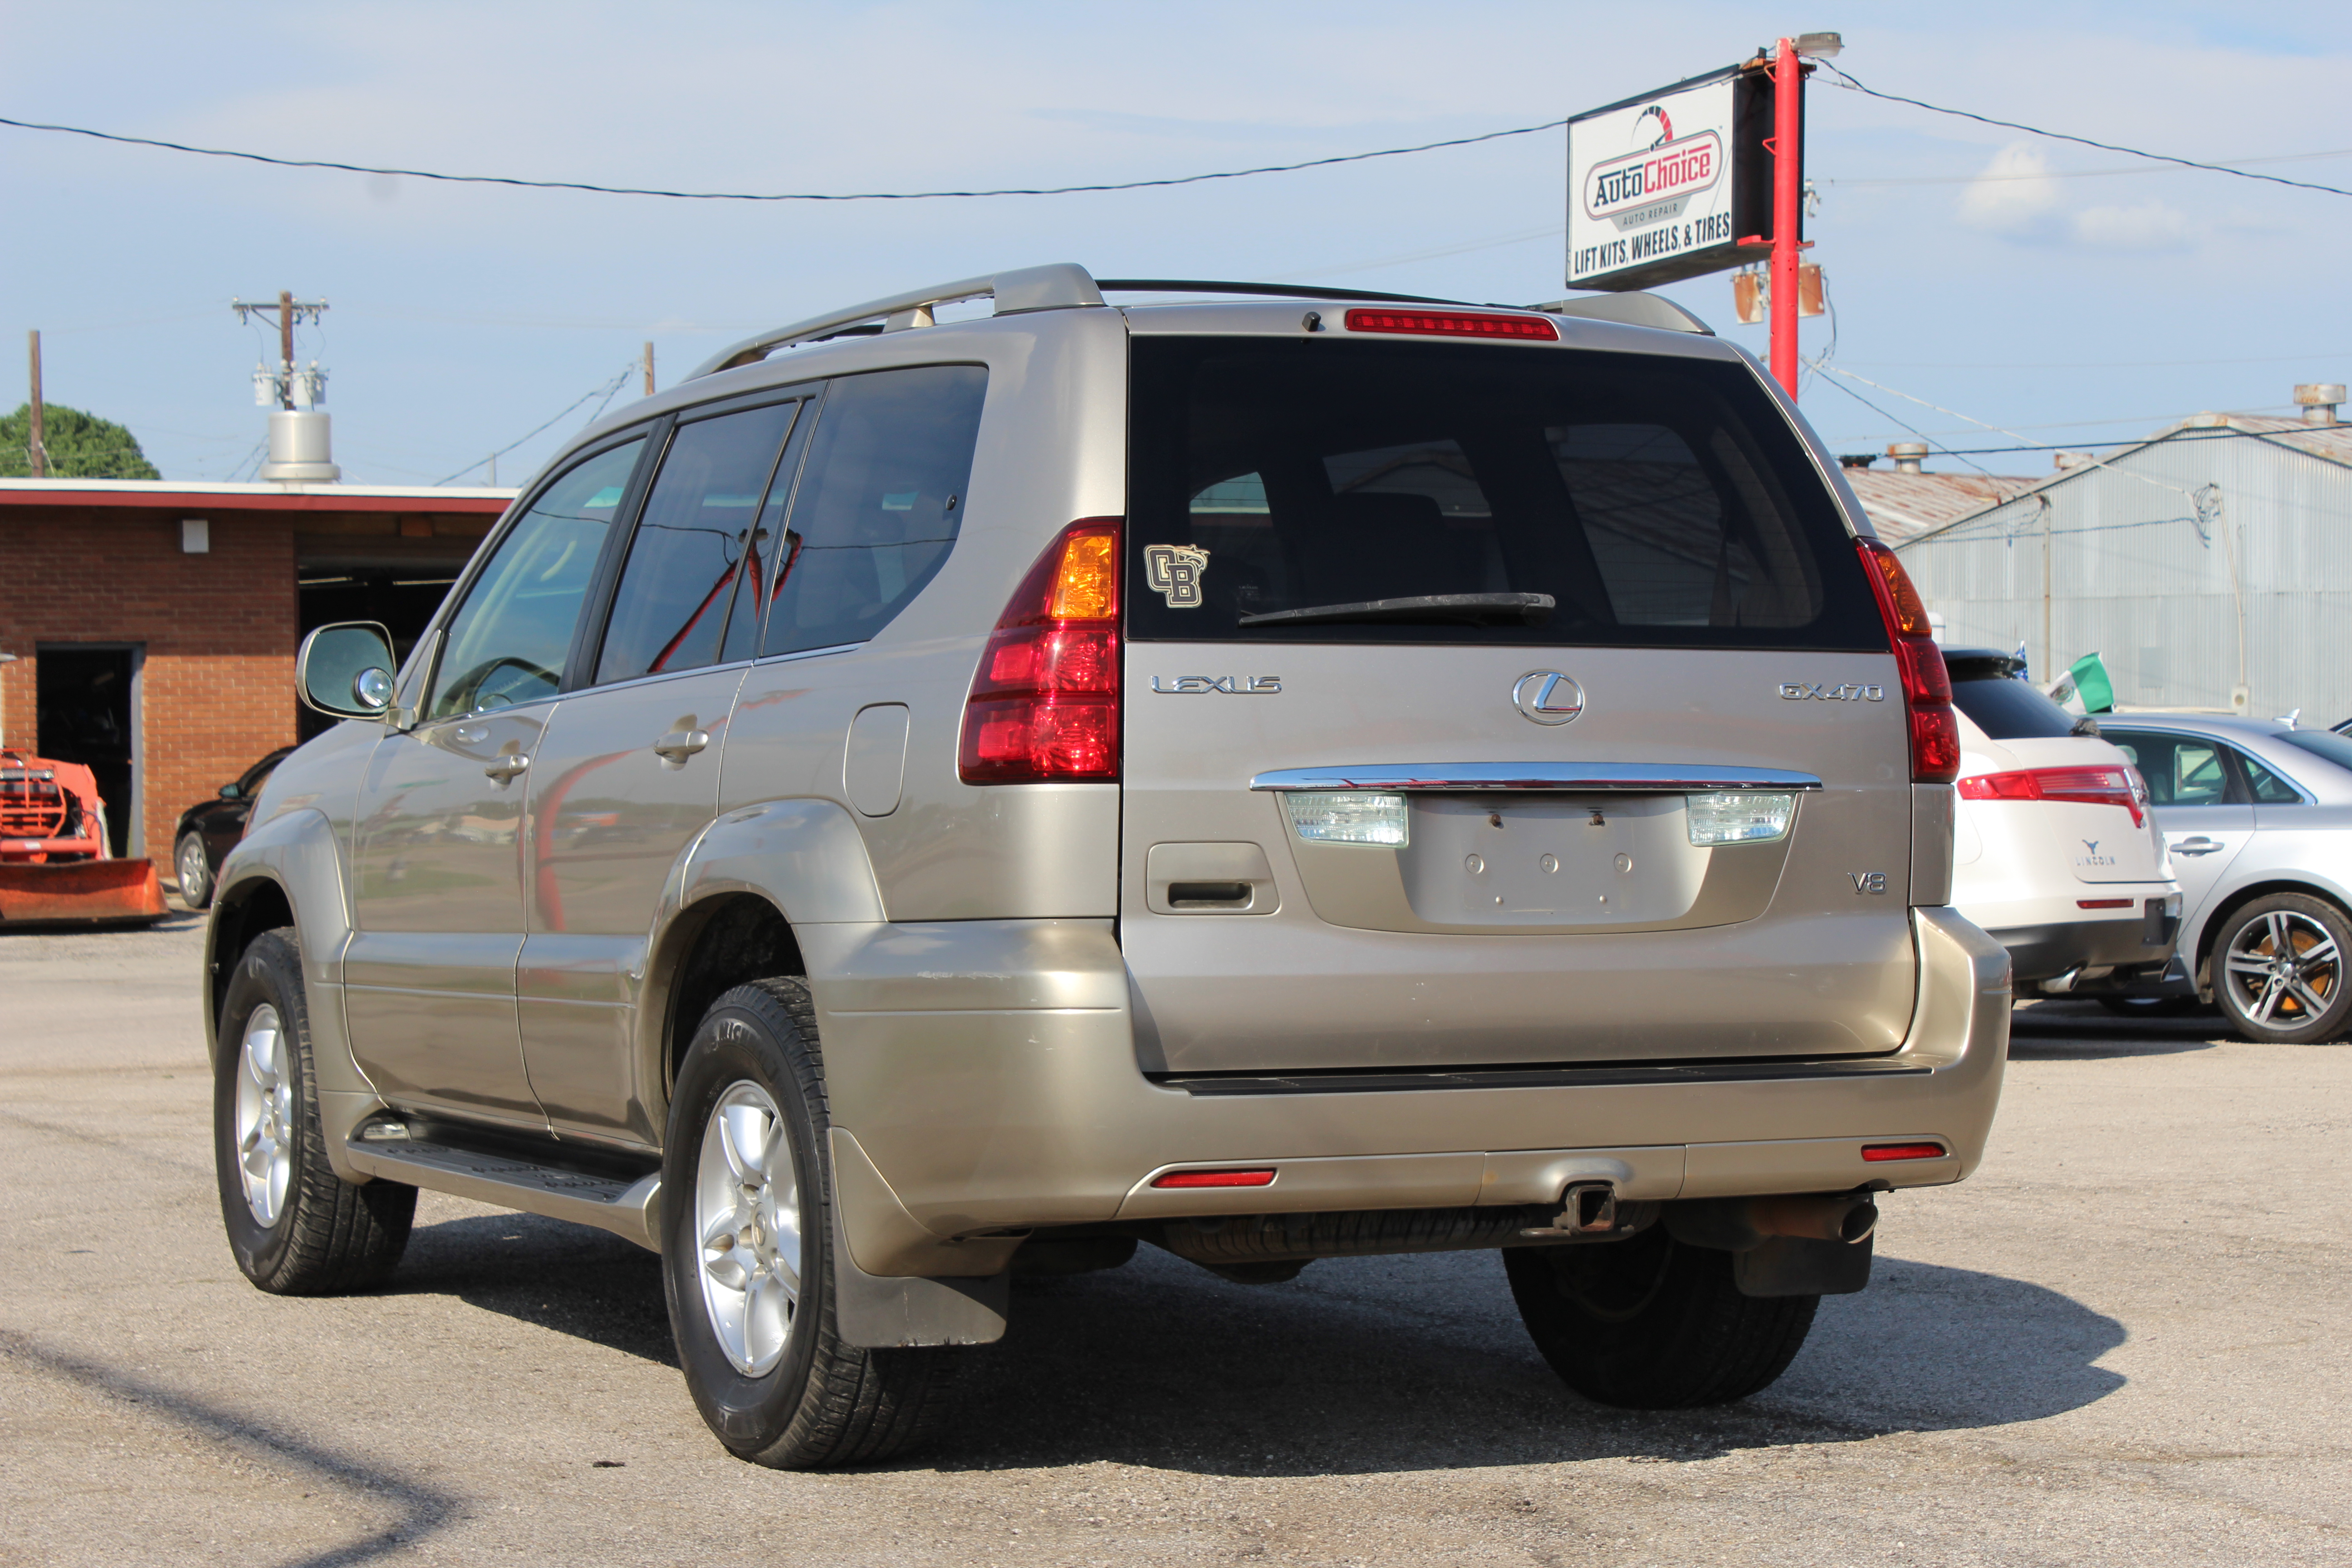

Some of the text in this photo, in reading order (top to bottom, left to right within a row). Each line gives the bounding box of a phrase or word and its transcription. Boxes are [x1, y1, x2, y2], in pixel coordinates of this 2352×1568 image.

[1593, 143, 1711, 208] AutoChoice
[1623, 203, 1678, 226] AUTO REPAIR
[1574, 211, 1730, 274] LIFT KITS, WHEELS, & TIRES
[1150, 676, 1282, 694] LEXUS
[2075, 856, 2115, 866] LINCOLN
[1847, 872, 1886, 894] V8
